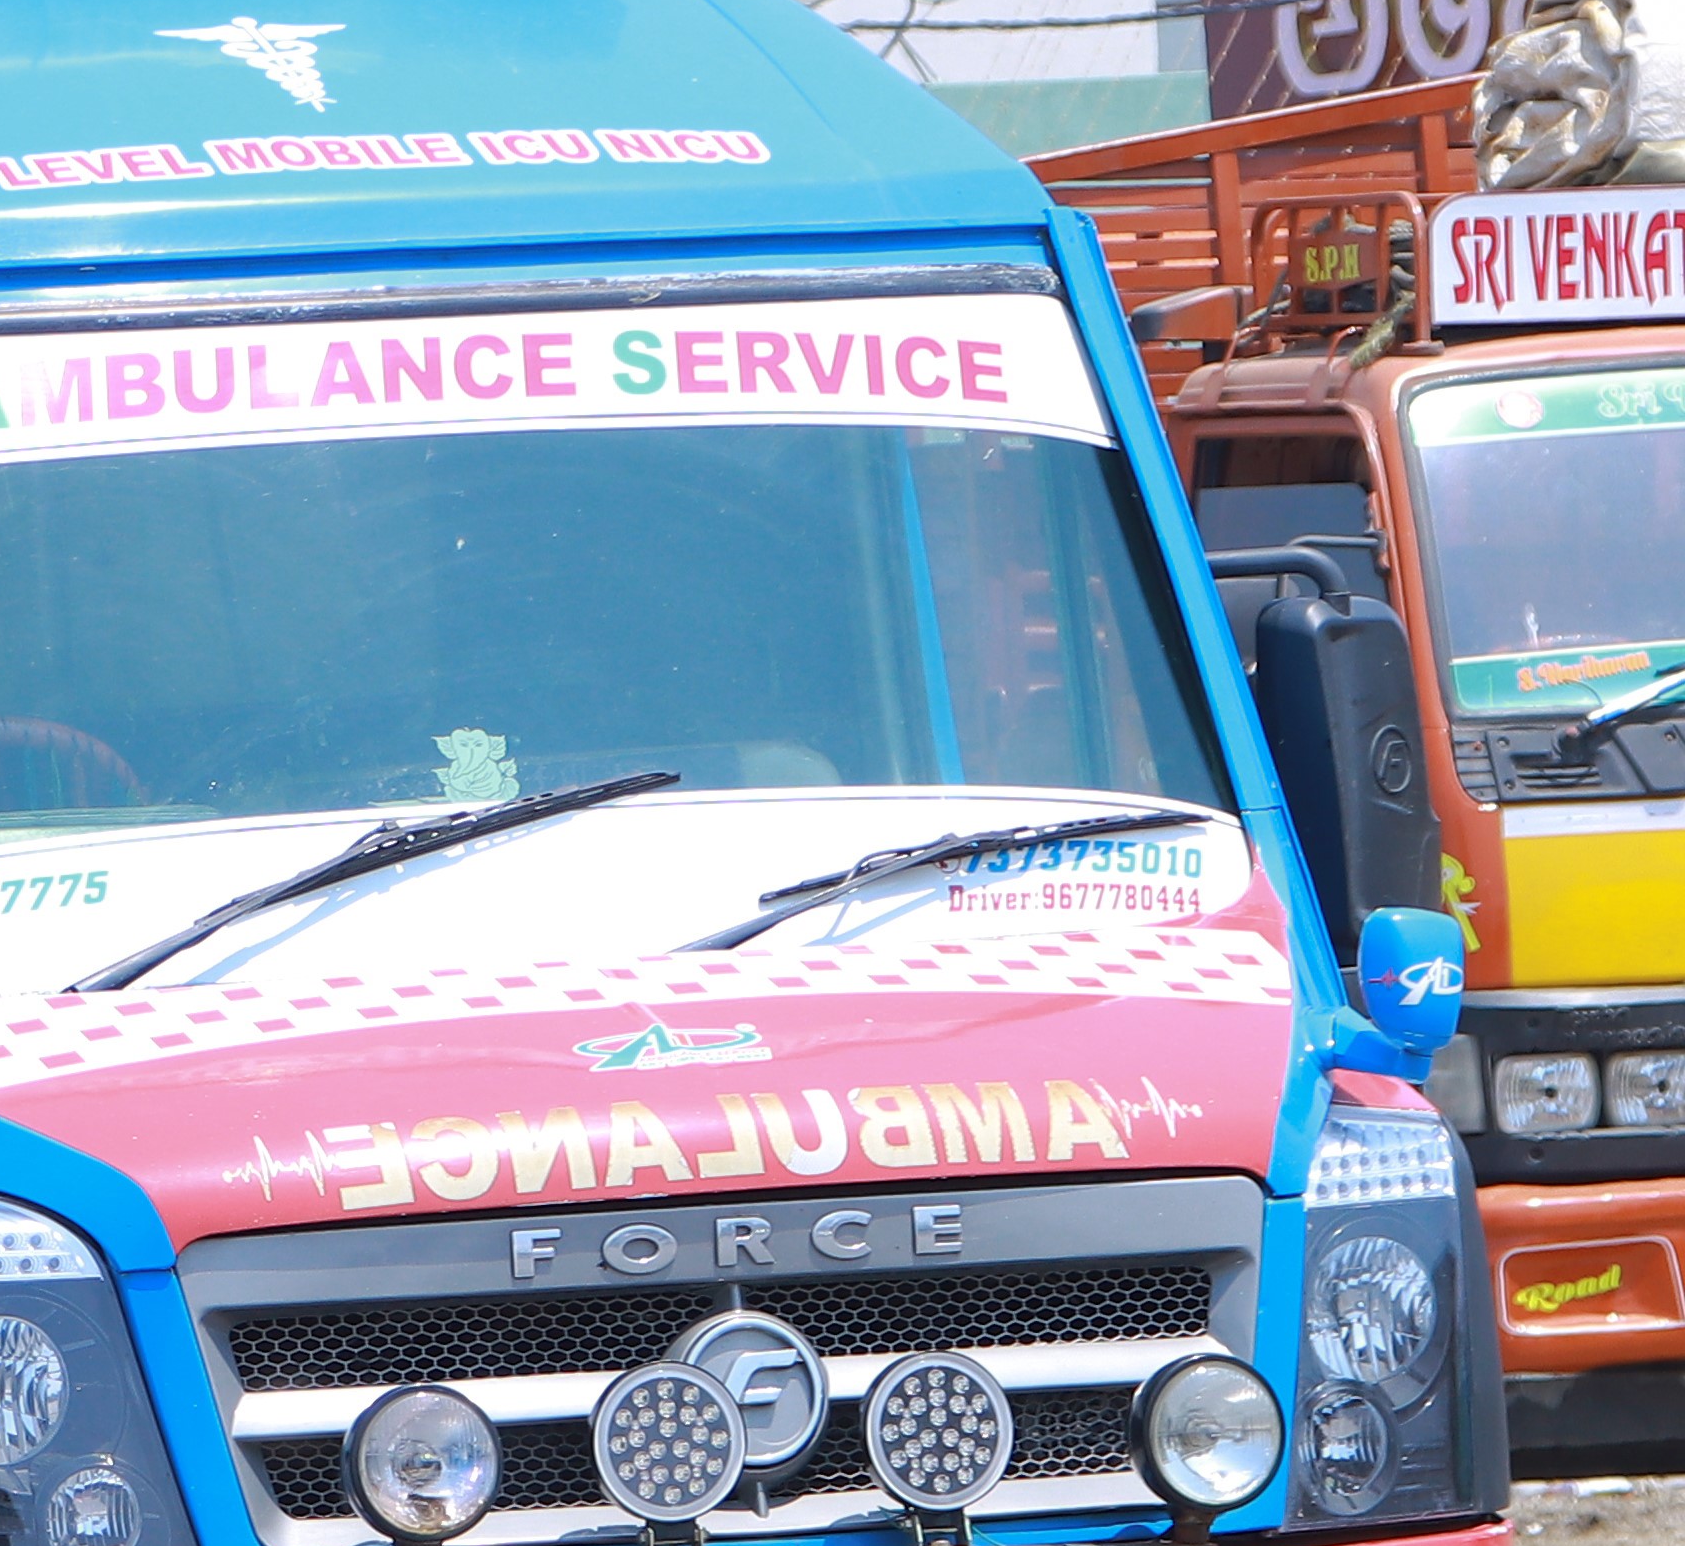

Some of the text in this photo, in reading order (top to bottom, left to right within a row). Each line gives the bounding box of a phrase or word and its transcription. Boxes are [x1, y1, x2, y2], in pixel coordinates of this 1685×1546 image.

[2, 147, 195, 188] LEVEL
[215, 133, 465, 175] MOBILE
[480, 129, 591, 162] ICU
[621, 129, 769, 163] NICU
[1451, 216, 1515, 315] SRI
[611, 327, 1009, 404] SERVICE
[510, 1203, 966, 1282] FORCE
